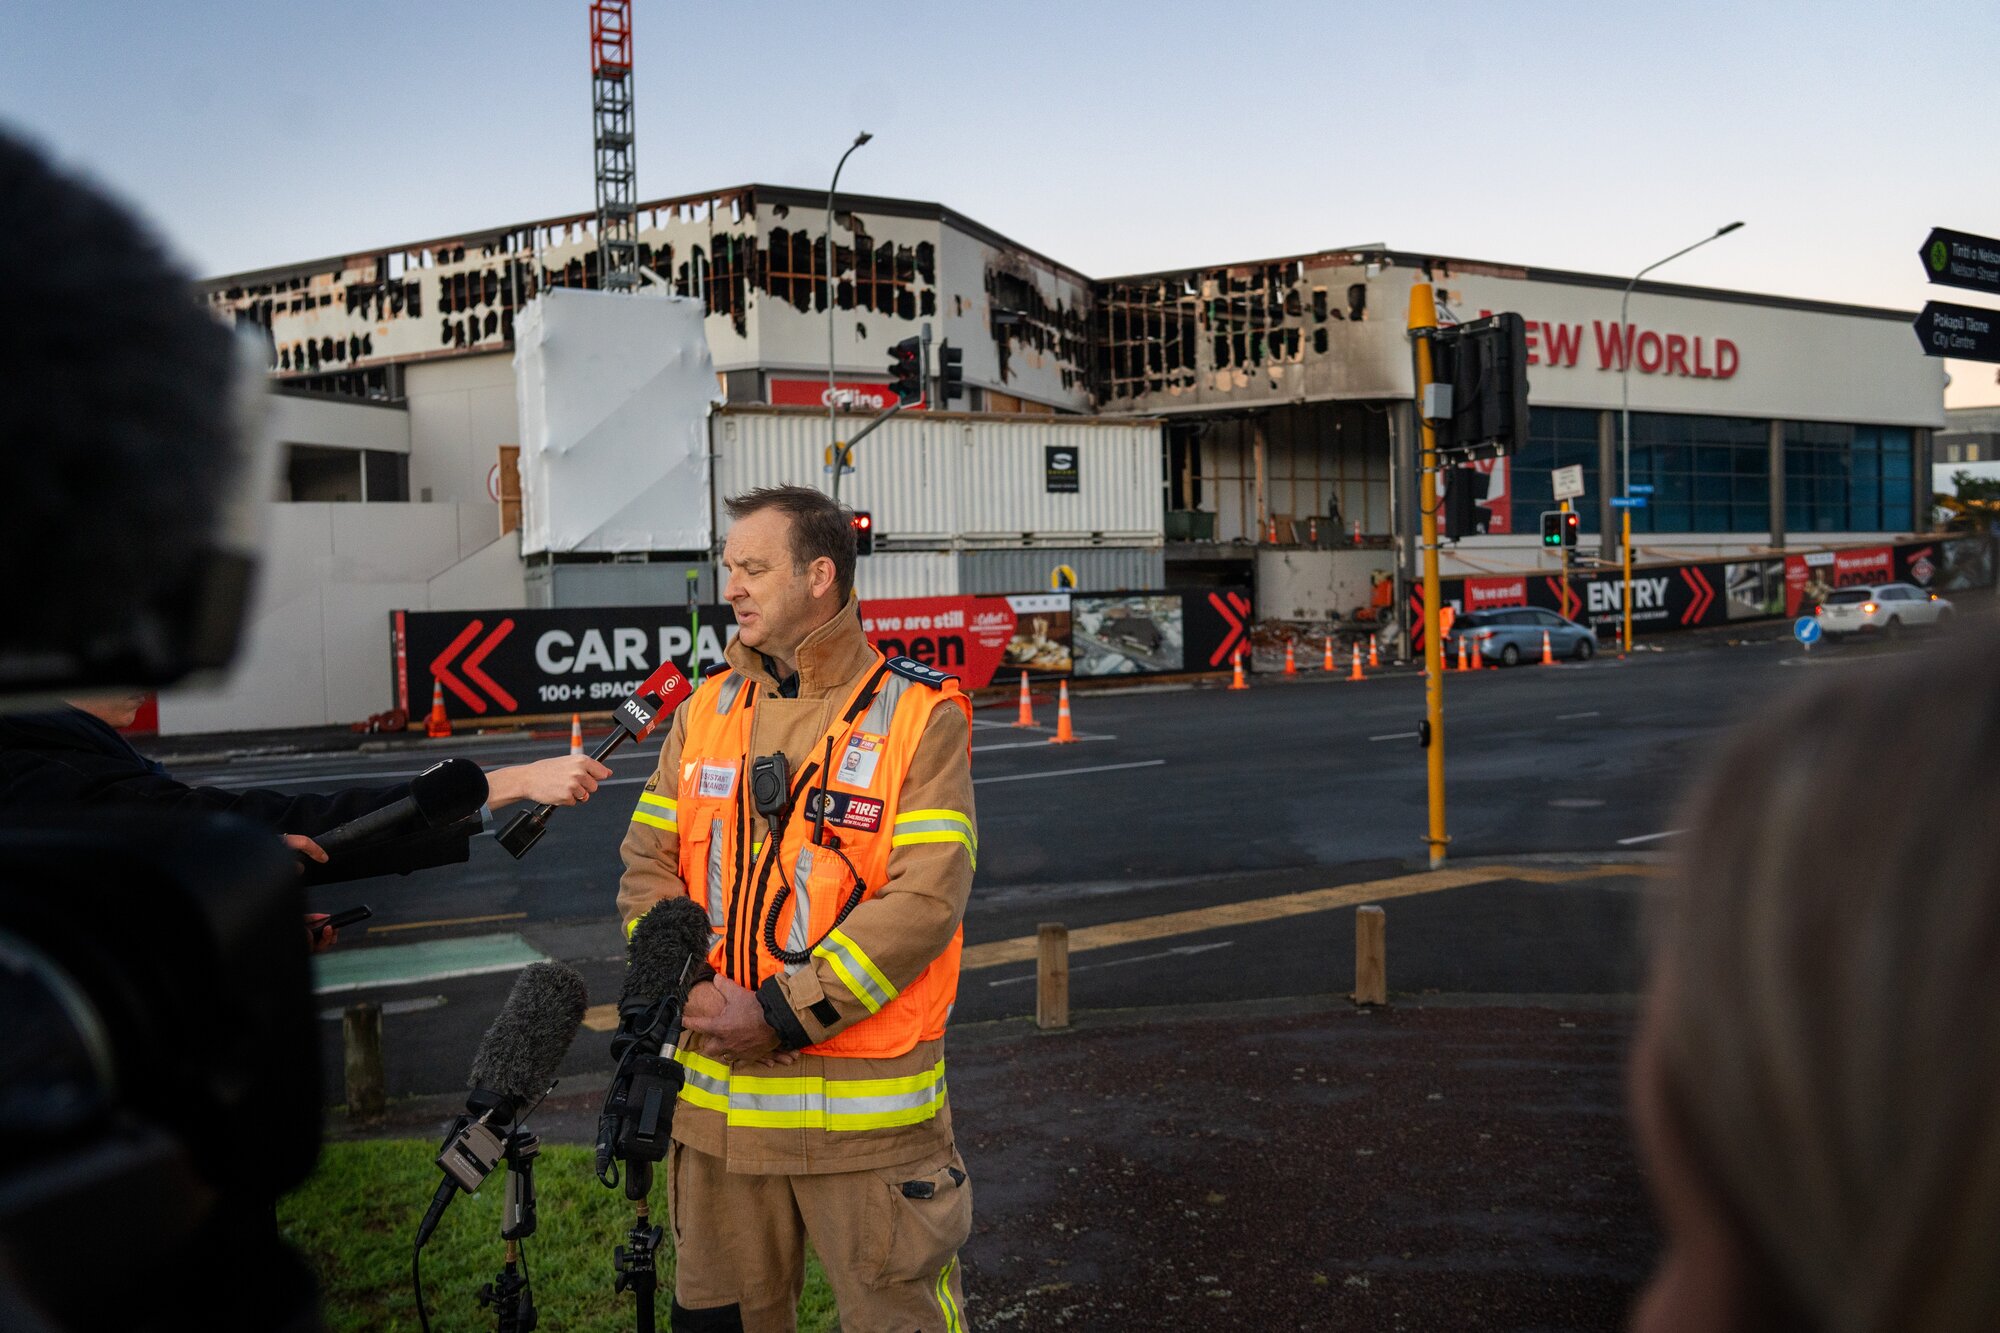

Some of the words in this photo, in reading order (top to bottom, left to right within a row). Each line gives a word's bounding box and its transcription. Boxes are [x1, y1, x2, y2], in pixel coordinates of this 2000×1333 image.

[1593, 320, 1740, 378] WORLD
[876, 617, 901, 631] we
[904, 616, 932, 630] are
[934, 610, 964, 629] still
[535, 628, 650, 674] CAR
[658, 624, 740, 668] PA
[878, 635, 965, 667] pen
[538, 683, 585, 701] 100+
[589, 680, 641, 699] SPAC
[624, 700, 651, 725] RNZ
[847, 800, 881, 817] FIRE
